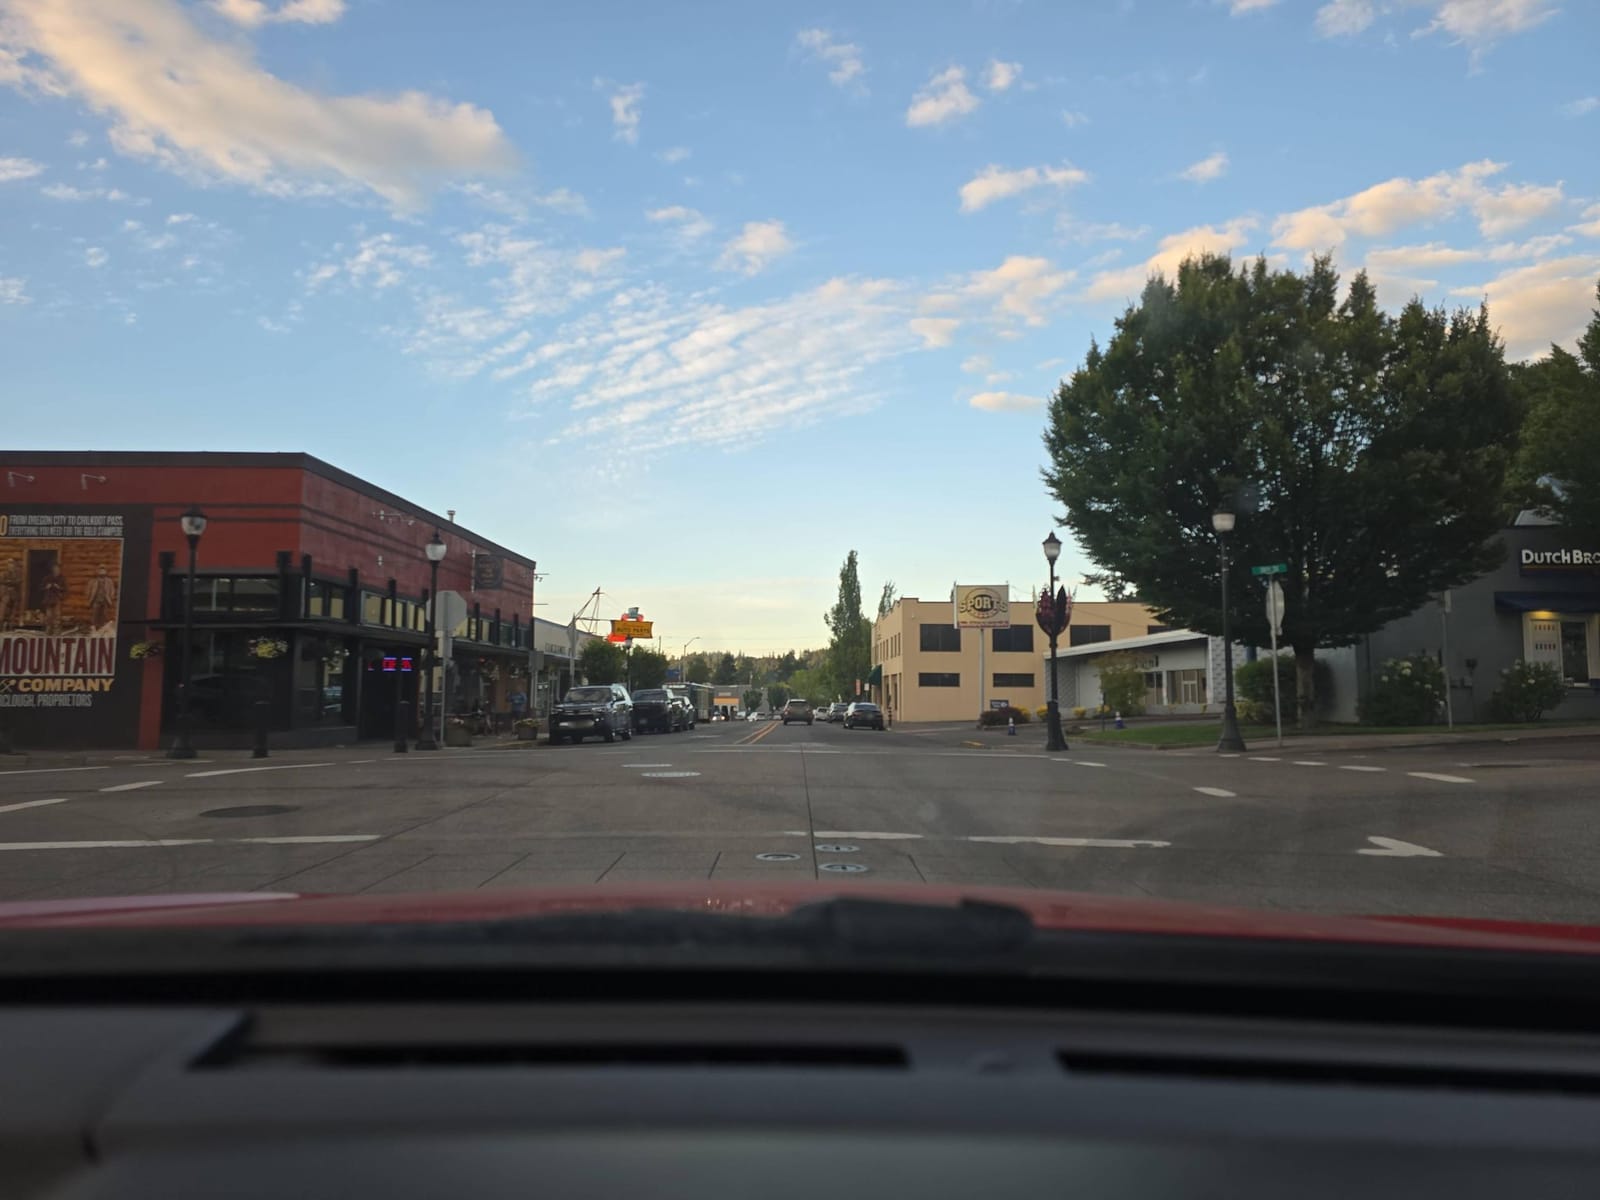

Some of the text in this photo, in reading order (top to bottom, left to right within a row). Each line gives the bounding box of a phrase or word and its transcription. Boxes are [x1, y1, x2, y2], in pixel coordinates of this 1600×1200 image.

[9, 515, 28, 526] FROM
[28, 515, 52, 526] OREGON
[53, 515, 66, 526] CITY
[67, 515, 76, 526] TO
[959, 596, 1009, 613] SPORTS
[18, 678, 115, 692] COMPANY
[37, 694, 93, 707] PROPRIETORS
